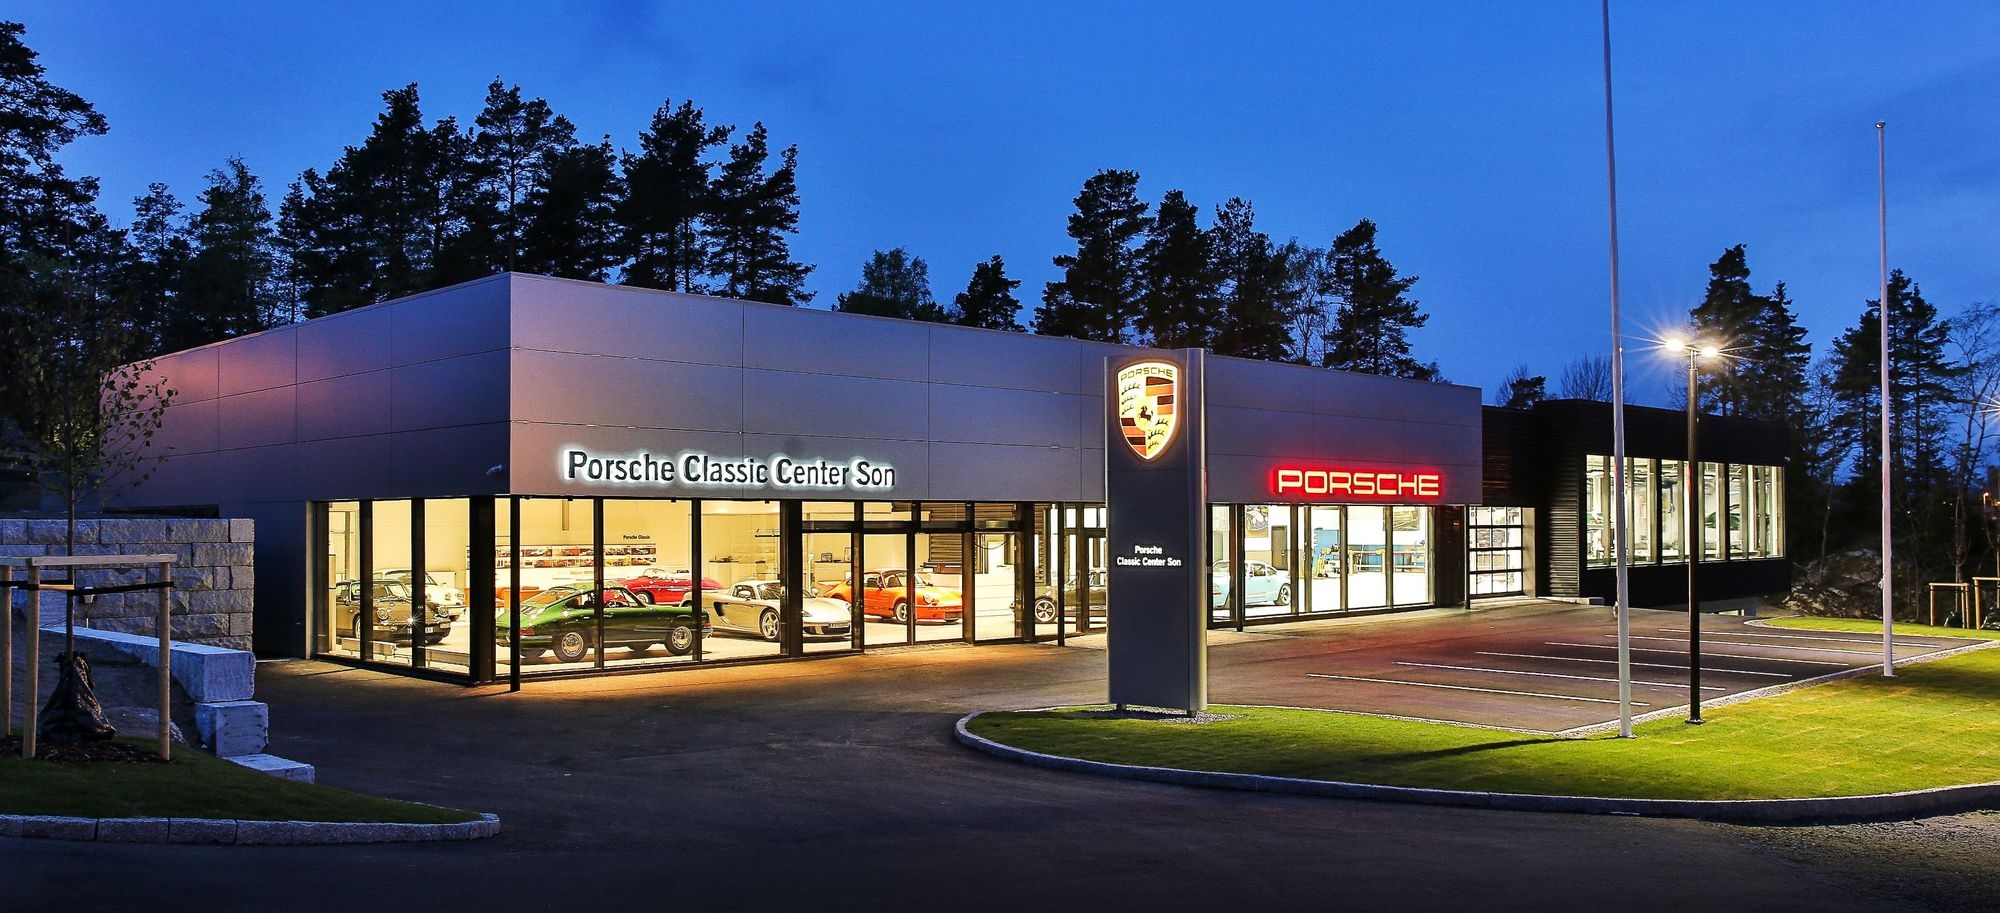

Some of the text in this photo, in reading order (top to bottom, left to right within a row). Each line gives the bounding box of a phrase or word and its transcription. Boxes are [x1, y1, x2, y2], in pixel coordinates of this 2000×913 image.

[1120, 366, 1173, 381] PORSCHE
[567, 450, 896, 487] Porsche Classic Center Son
[1277, 469, 1439, 496] PORSCHE
[1134, 545, 1162, 554] Porsche
[1116, 557, 1181, 566] Classic Center Son
